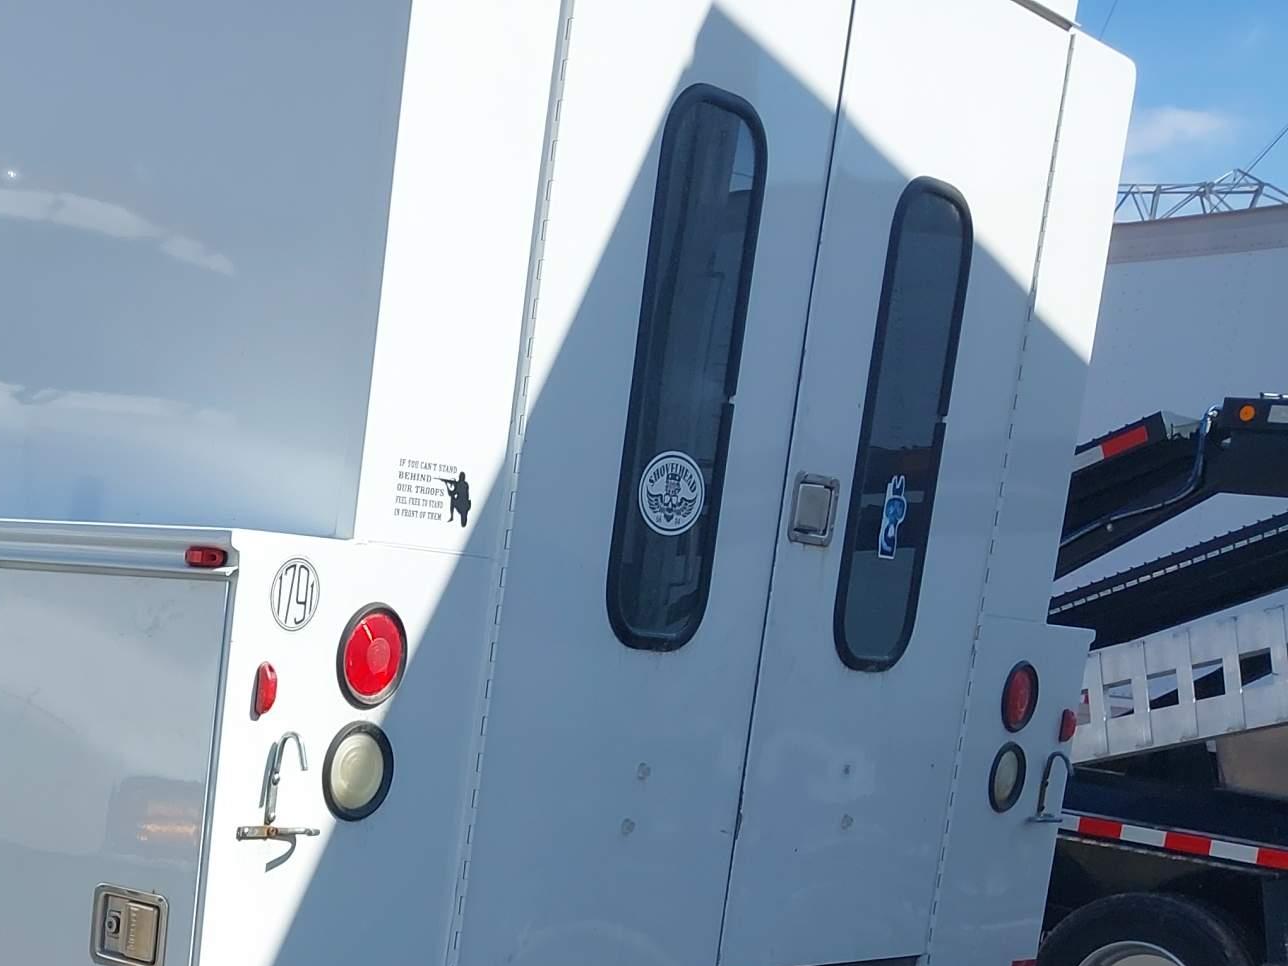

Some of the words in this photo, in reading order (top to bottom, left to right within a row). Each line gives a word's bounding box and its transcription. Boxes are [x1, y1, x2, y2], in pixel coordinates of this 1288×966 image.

[399, 458, 406, 467] IF
[438, 464, 458, 474] STAND
[398, 471, 432, 483] BEHIND
[648, 463, 697, 493] SHOVELHEAD
[396, 483, 413, 493] OUR
[415, 485, 445, 497] TROOPS
[394, 507, 400, 516] IN
[401, 508, 419, 518] FRONT
[427, 511, 442, 521] THEM
[277, 563, 315, 625] 1791
